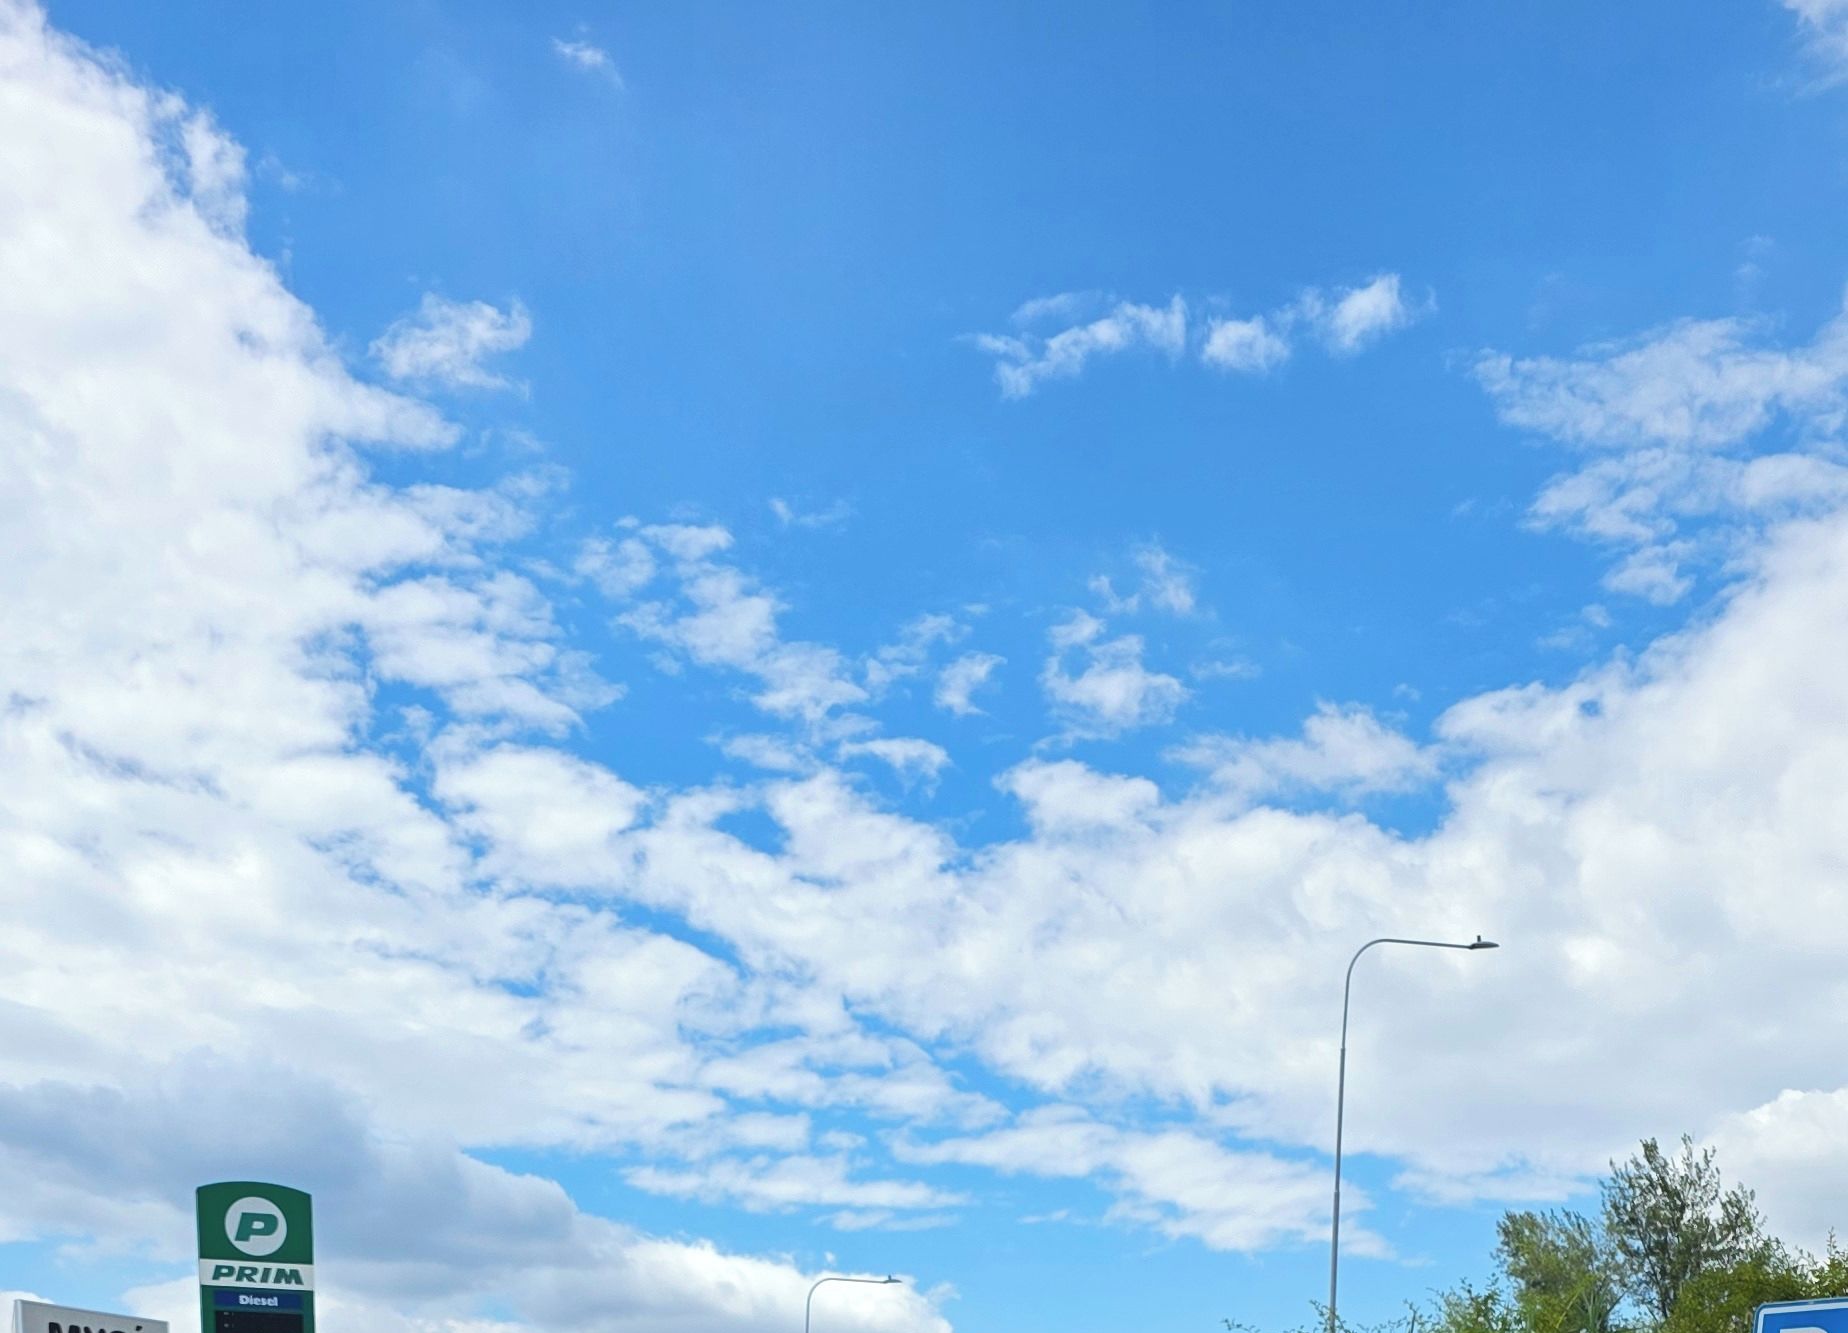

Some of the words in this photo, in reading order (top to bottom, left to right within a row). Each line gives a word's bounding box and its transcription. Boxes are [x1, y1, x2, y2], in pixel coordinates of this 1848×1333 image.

[235, 1212, 279, 1242] P
[212, 1264, 304, 1286] PRIM
[238, 1294, 278, 1306] Diesel
